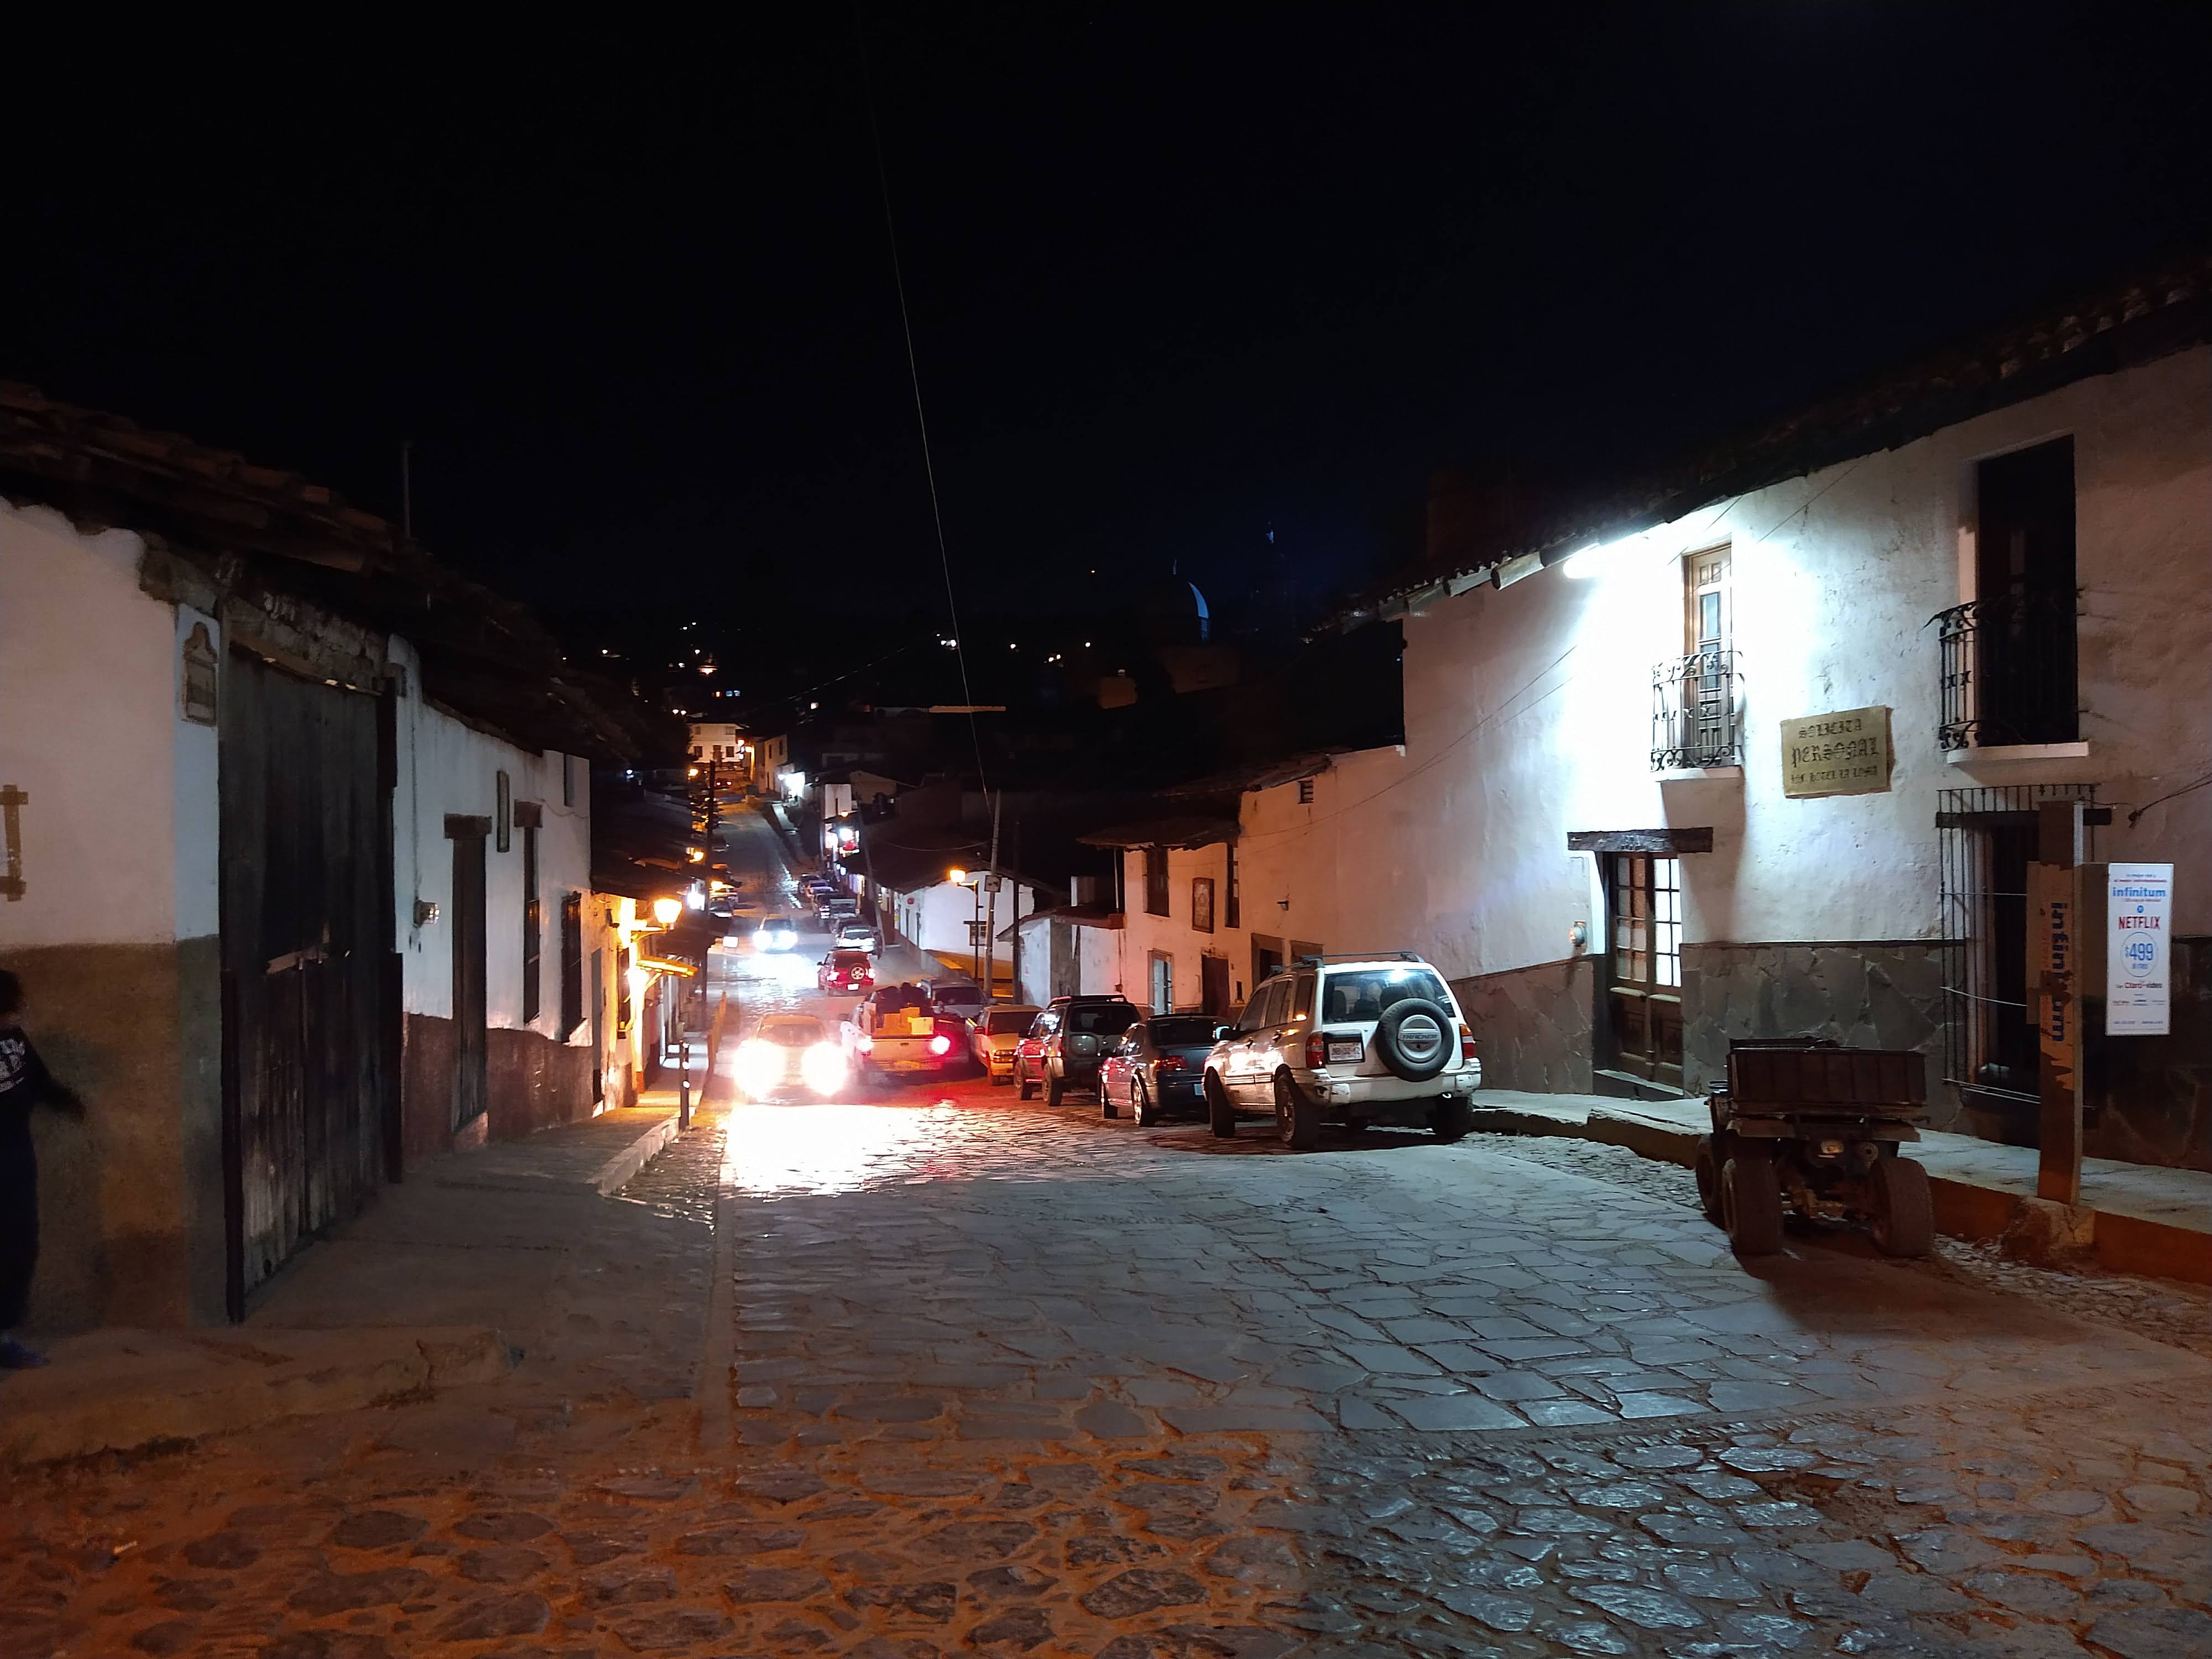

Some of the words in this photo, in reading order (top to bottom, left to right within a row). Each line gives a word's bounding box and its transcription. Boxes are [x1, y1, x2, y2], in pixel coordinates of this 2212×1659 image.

[1792, 737, 1879, 768] PERSONAL
[2112, 887, 2166, 896] infinitum
[2118, 916, 2161, 930] NETFLIX
[2125, 943, 2153, 961] $499
